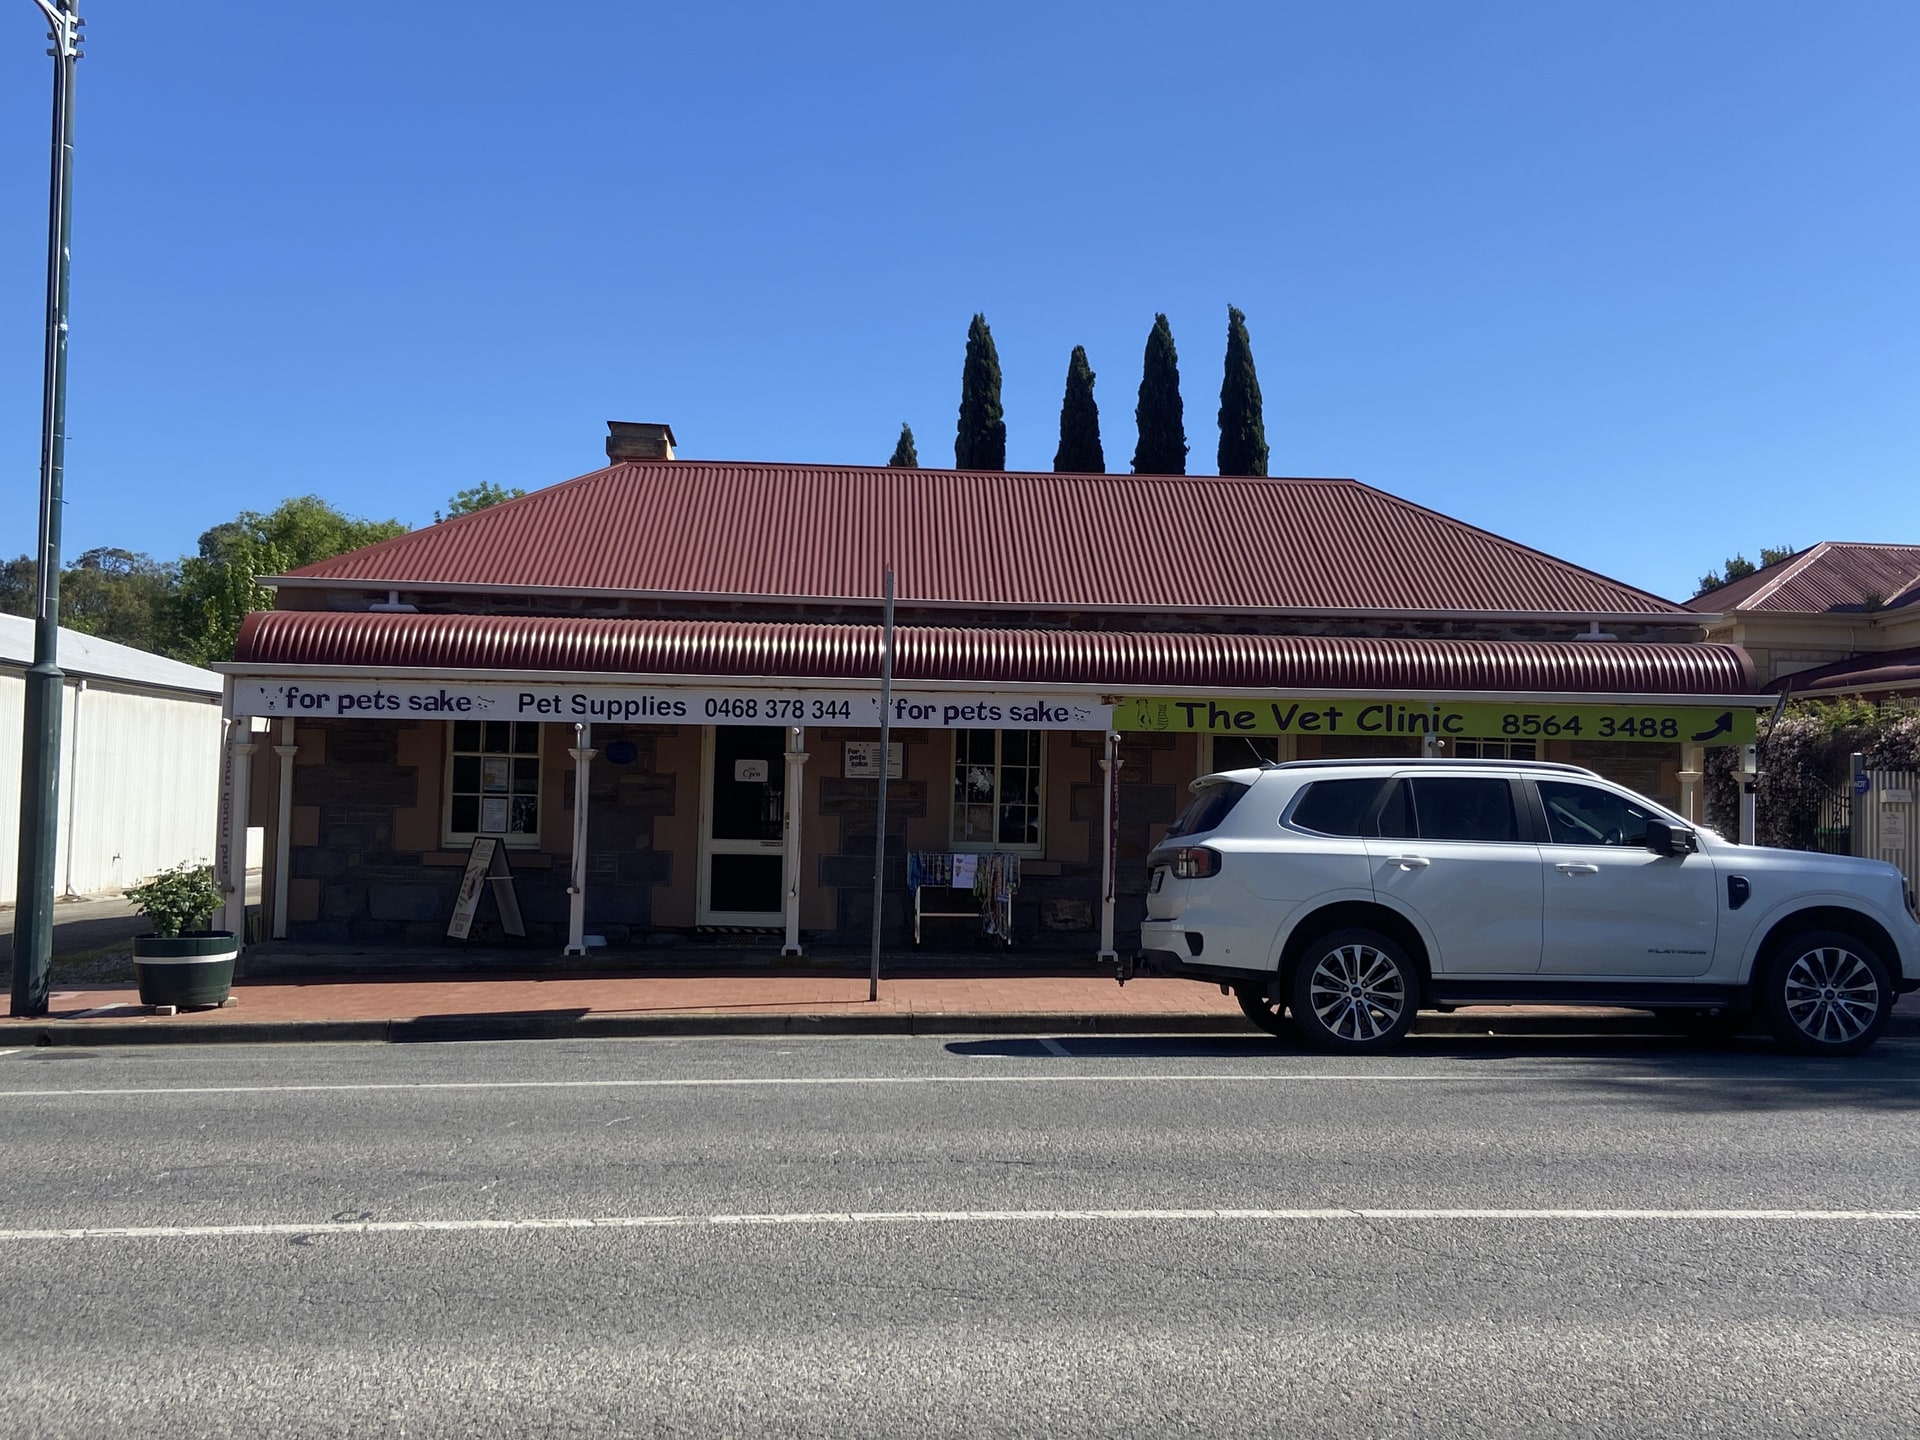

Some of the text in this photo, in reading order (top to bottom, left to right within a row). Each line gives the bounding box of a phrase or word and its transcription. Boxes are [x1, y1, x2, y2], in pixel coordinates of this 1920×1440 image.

[286, 687, 472, 714] for pets sake
[518, 693, 851, 720] Pet Supplies 0468 378 344
[895, 698, 1069, 725] for pets sake
[1175, 701, 1679, 738] The Vet Clinic 8564 3488
[221, 792, 230, 838] much
[220, 844, 229, 874] and
